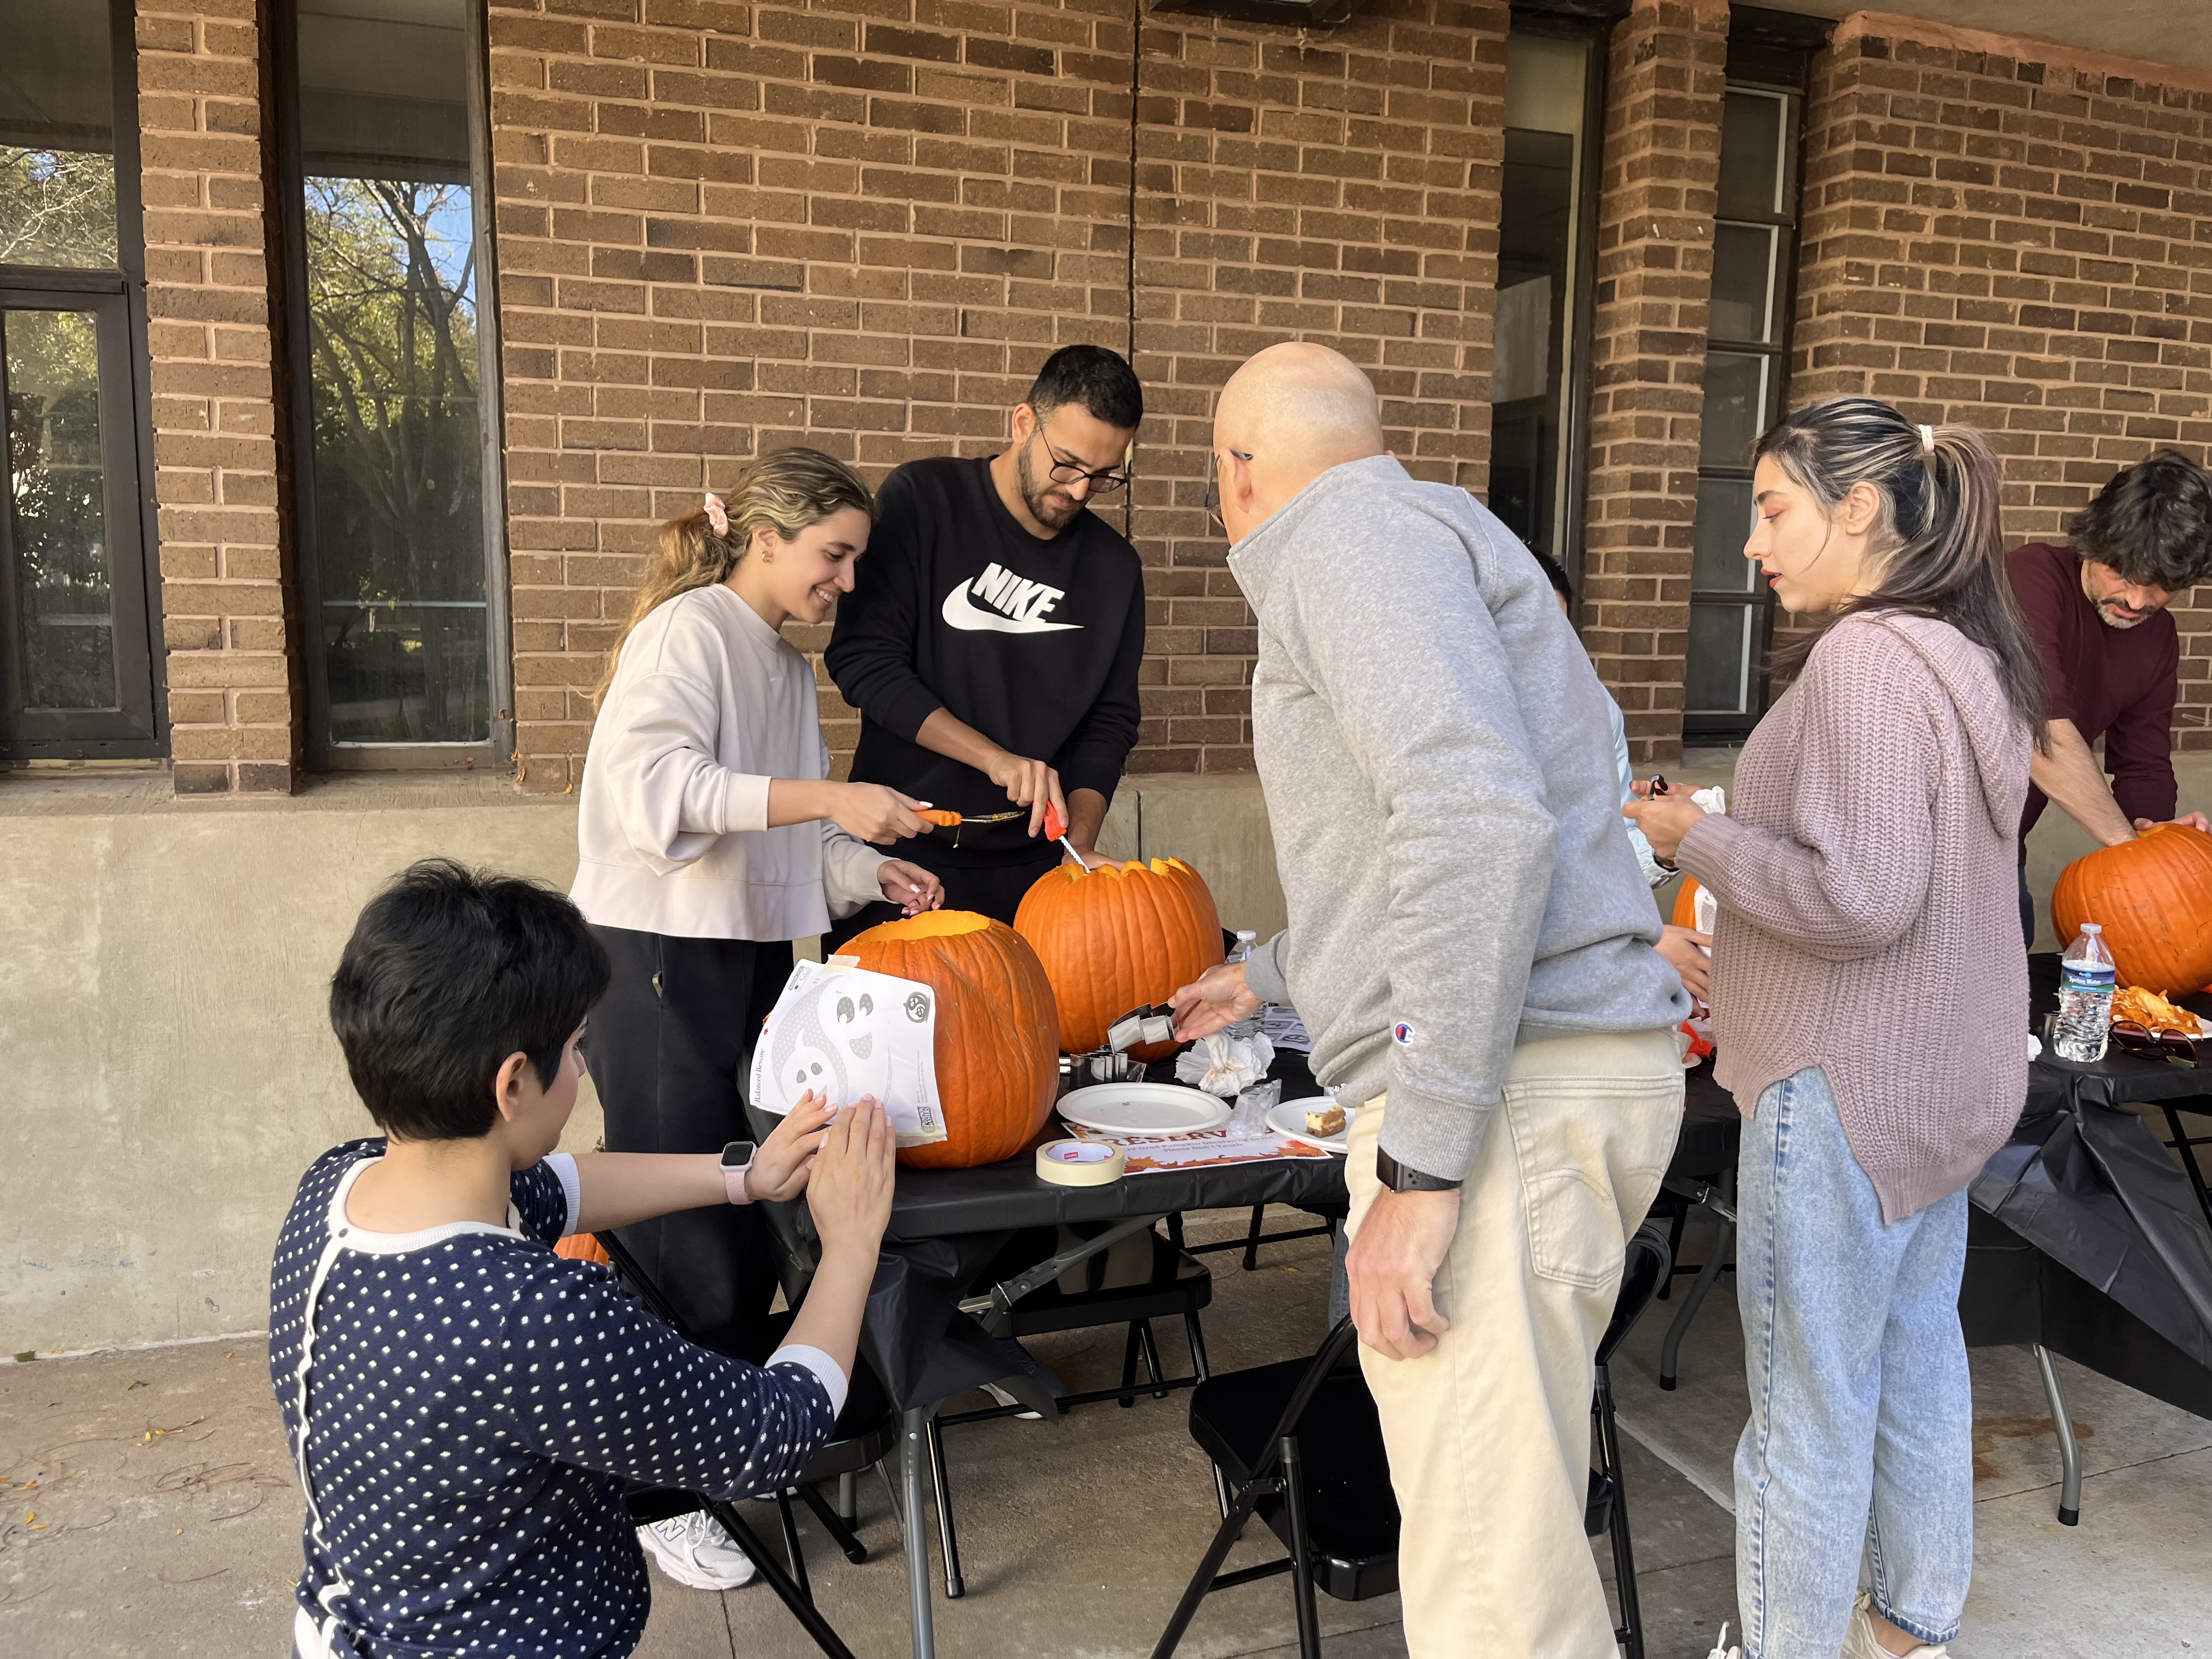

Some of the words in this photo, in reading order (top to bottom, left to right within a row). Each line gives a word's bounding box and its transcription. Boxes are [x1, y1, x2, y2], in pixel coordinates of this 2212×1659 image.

[971, 562, 1065, 623] NIKE
[2069, 976, 2085, 985] Spring
[756, 1048, 765, 1073] Beware
[1101, 1125, 1275, 1146] RESERV
